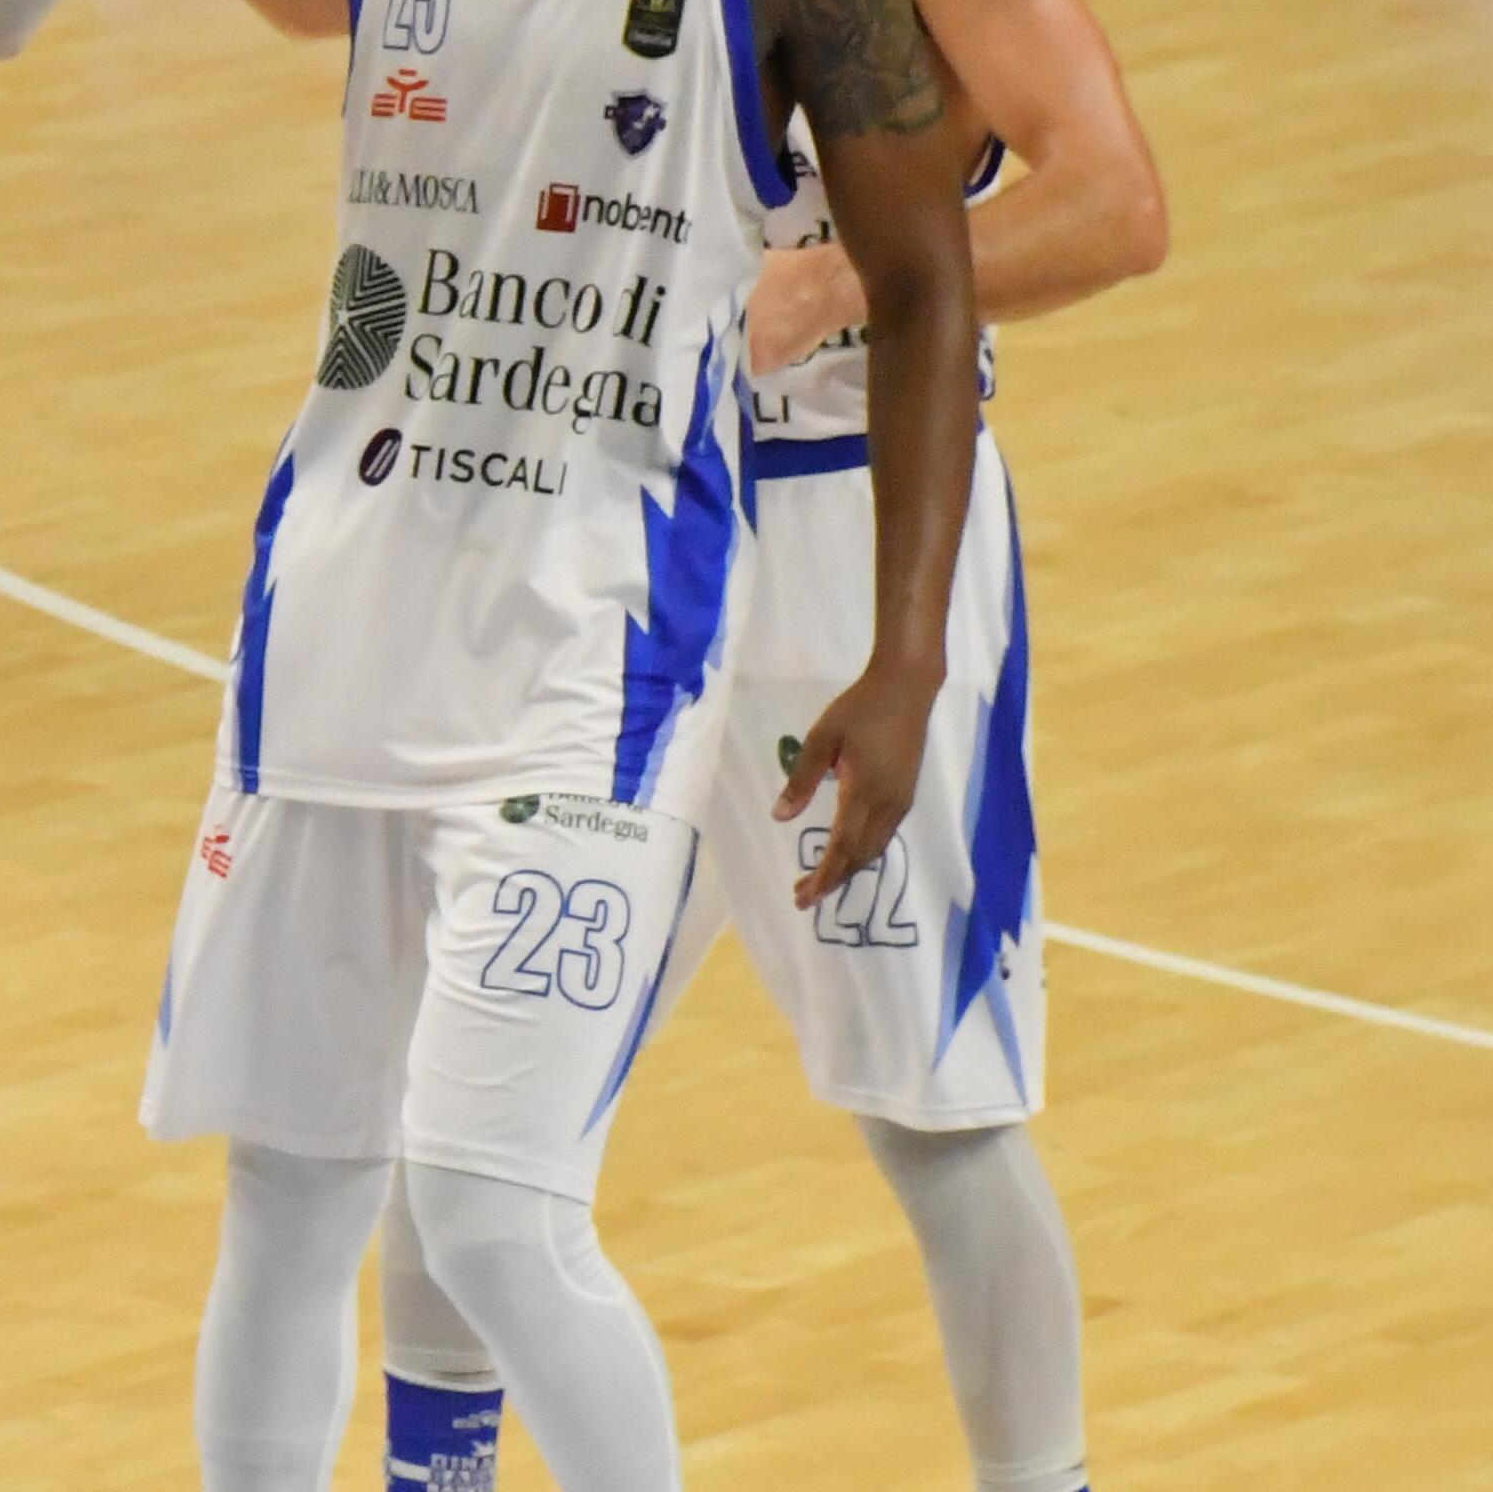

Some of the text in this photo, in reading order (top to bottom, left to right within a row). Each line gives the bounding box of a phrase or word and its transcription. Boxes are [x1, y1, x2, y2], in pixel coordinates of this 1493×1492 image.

[417, 246, 669, 349] Banco di
[403, 332, 663, 436] Sardegna
[410, 442, 568, 497] TISCALI
[544, 804, 649, 843] Sardegna
[480, 868, 632, 1012] 23
